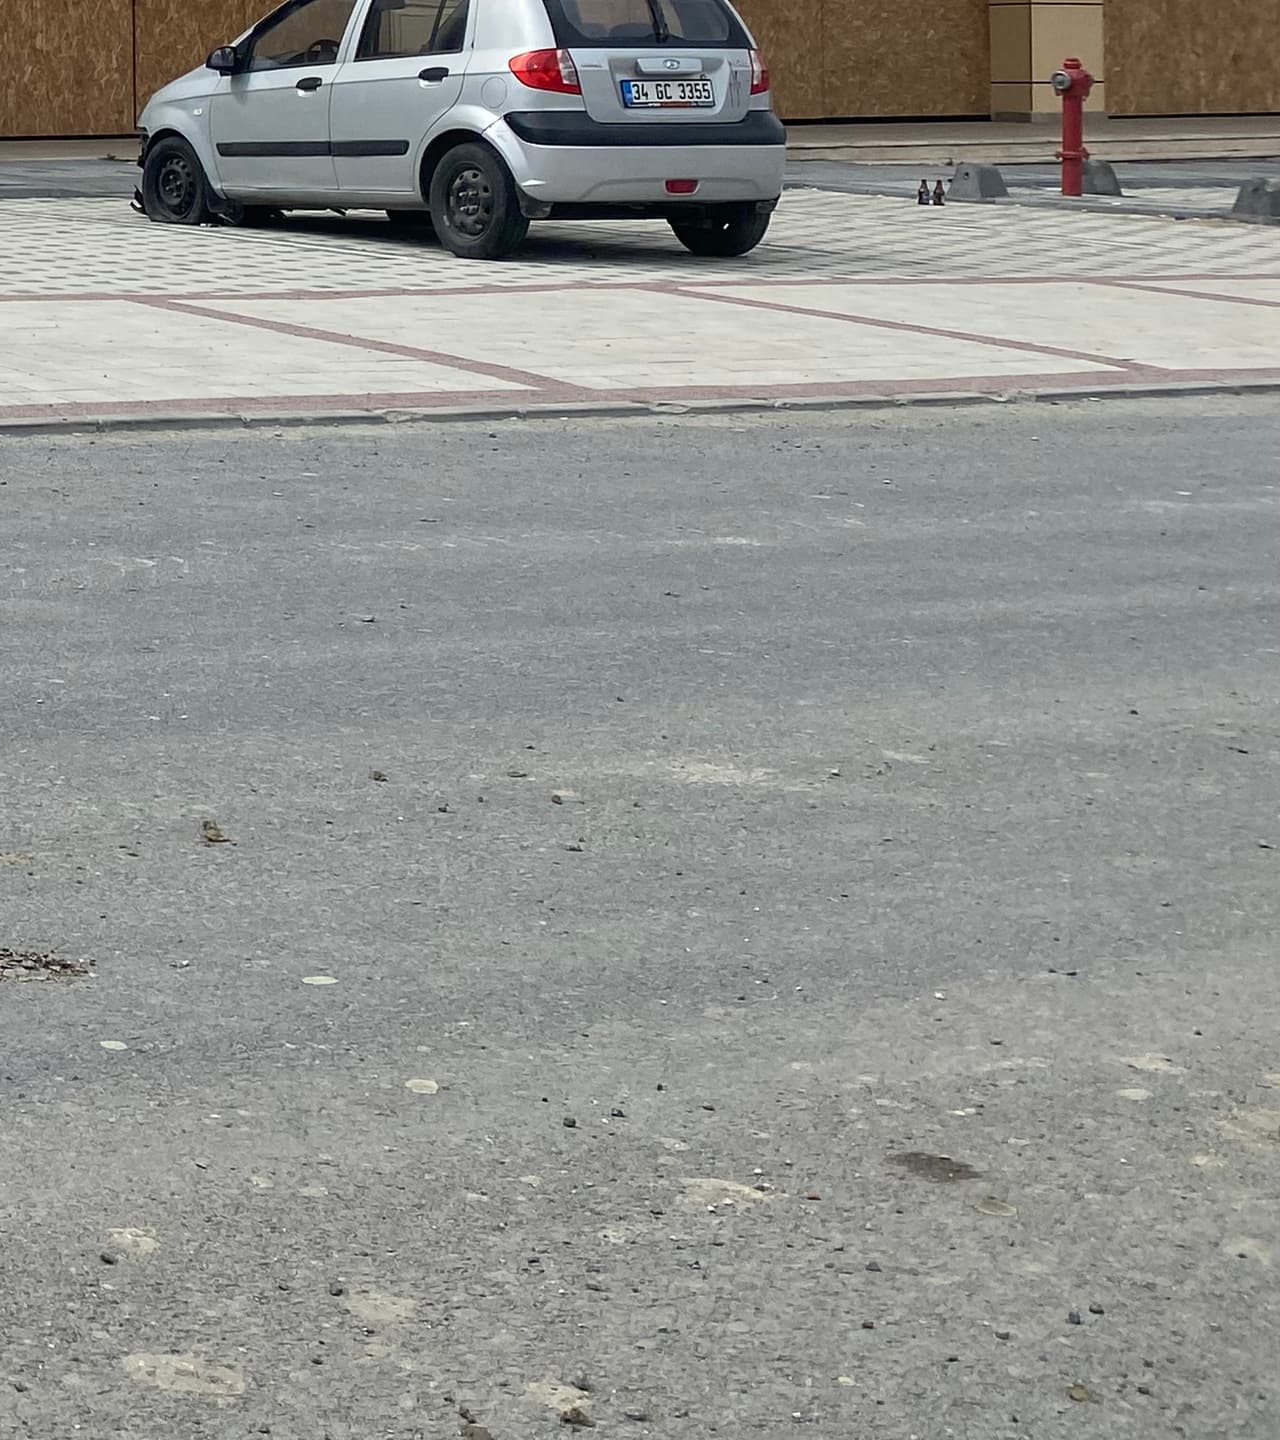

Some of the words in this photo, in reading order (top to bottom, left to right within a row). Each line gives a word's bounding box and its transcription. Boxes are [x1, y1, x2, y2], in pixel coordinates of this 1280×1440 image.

[632, 83, 649, 100] 34
[655, 83, 672, 100] GC
[677, 83, 710, 100] 3355
